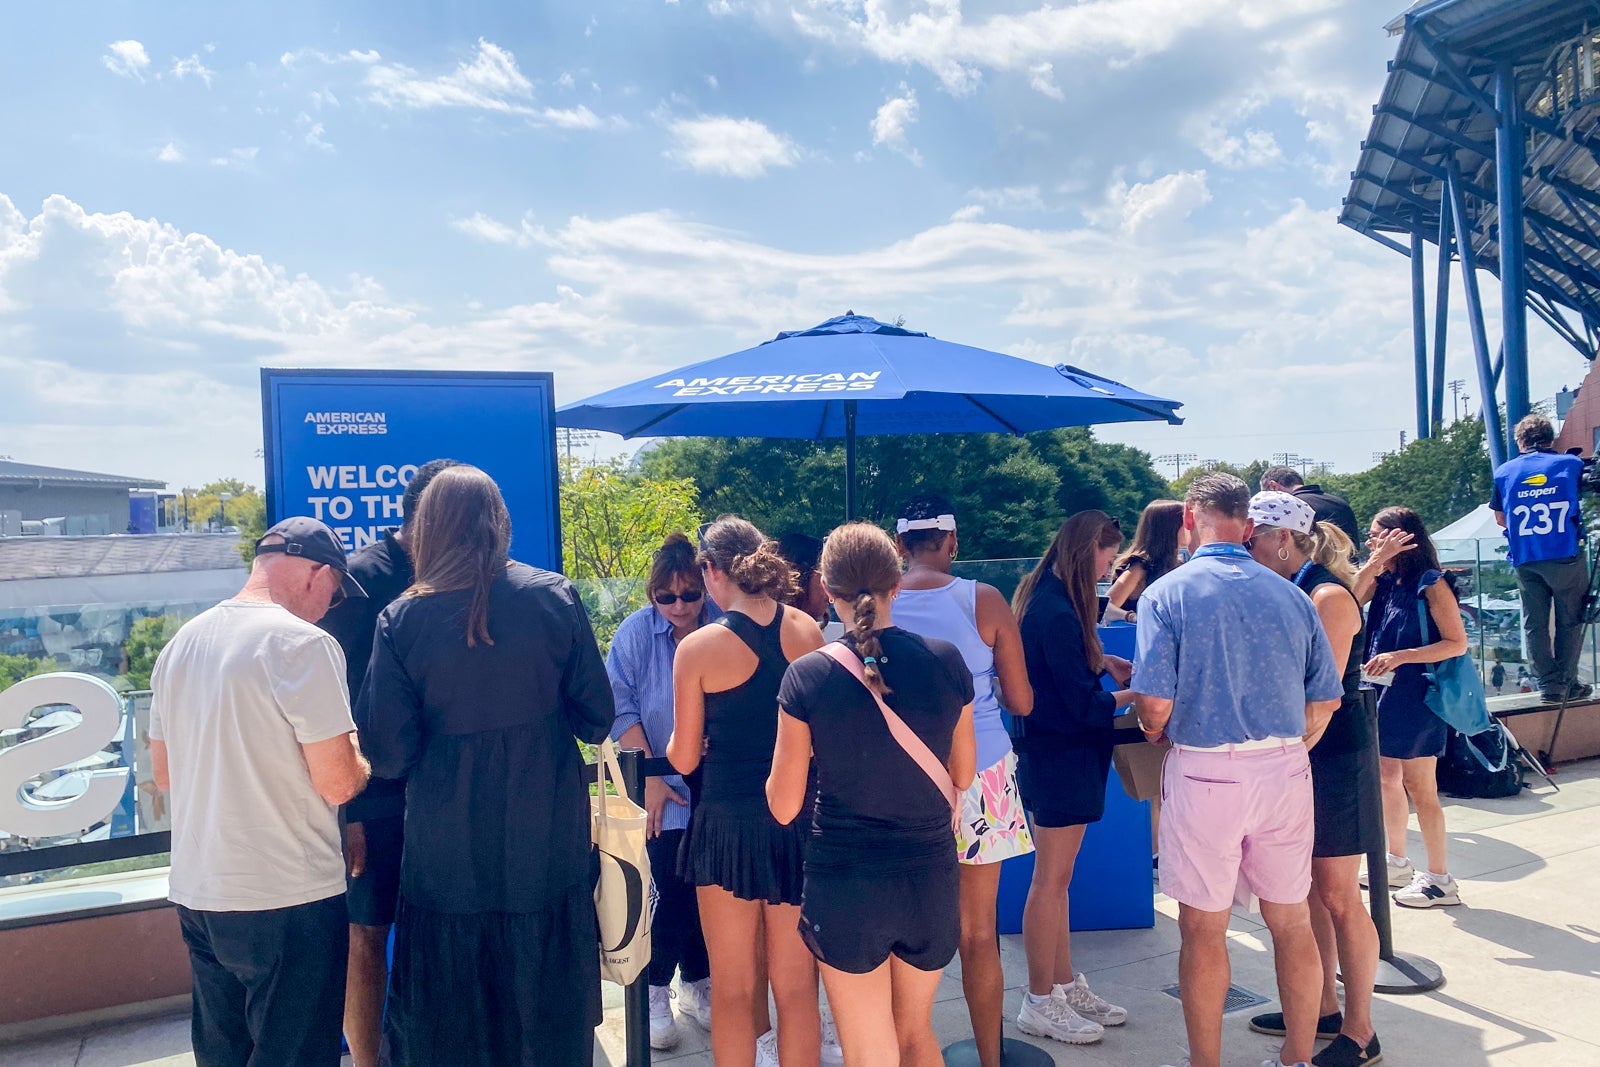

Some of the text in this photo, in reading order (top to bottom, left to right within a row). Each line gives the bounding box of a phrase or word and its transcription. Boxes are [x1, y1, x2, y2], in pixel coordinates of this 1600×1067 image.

[654, 370, 882, 388] AMERICAN
[672, 381, 878, 397] EXPRESS
[304, 412, 386, 423] AMERICAN
[317, 424, 387, 435] EXPRESS
[306, 464, 419, 489] WELCO
[308, 495, 404, 520] TO TH
[1513, 501, 1570, 536] 237
